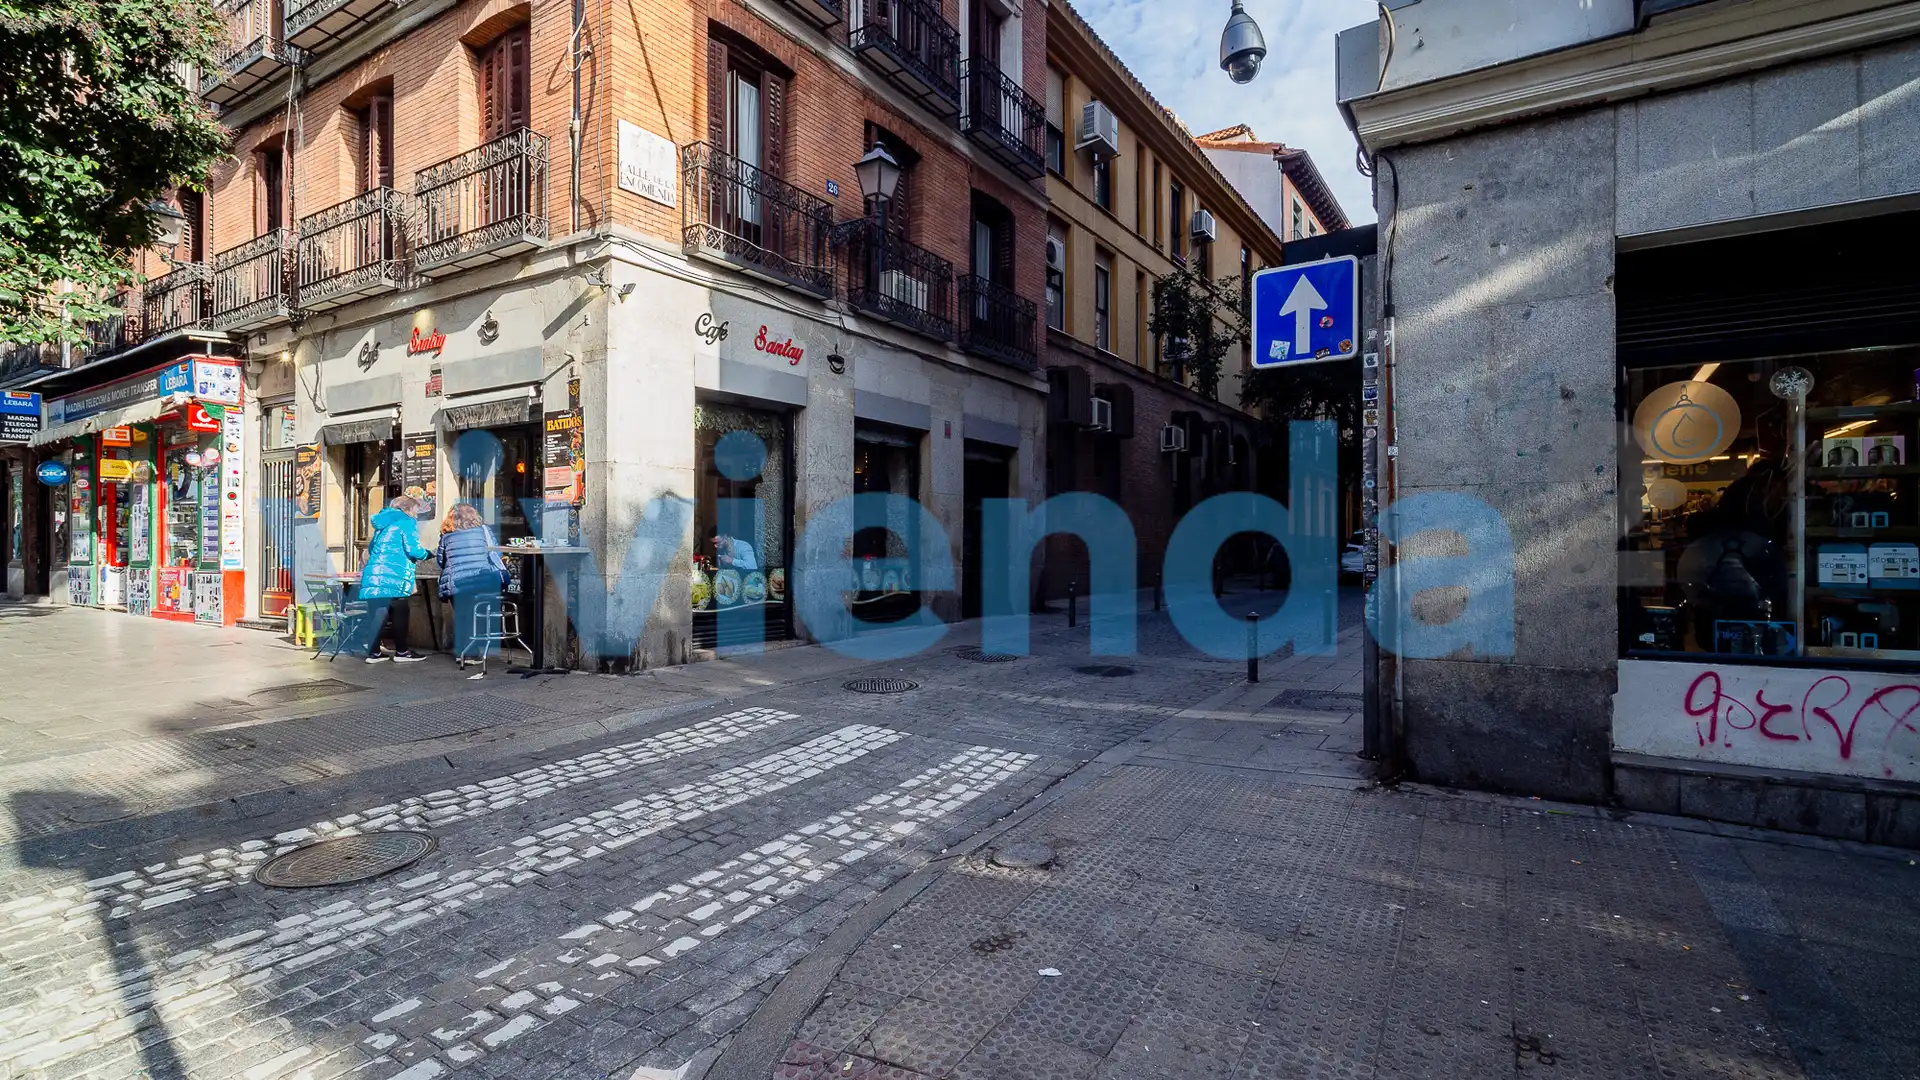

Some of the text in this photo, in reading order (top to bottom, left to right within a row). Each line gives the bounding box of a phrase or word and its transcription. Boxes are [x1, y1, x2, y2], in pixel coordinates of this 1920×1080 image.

[409, 327, 447, 355] Santay
[753, 324, 804, 366] Santay
[165, 374, 188, 391] LEBARA
[3, 399, 34, 407] LEBARA
[65, 402, 86, 414] MADINA
[85, 395, 108, 409] TELECOM
[111, 388, 130, 401] MONEY
[130, 378, 158, 397] TRANSFER
[191, 421, 218, 429] vodafone
[546, 415, 583, 431] BATIDOS
[38, 469, 67, 477] DIGI
